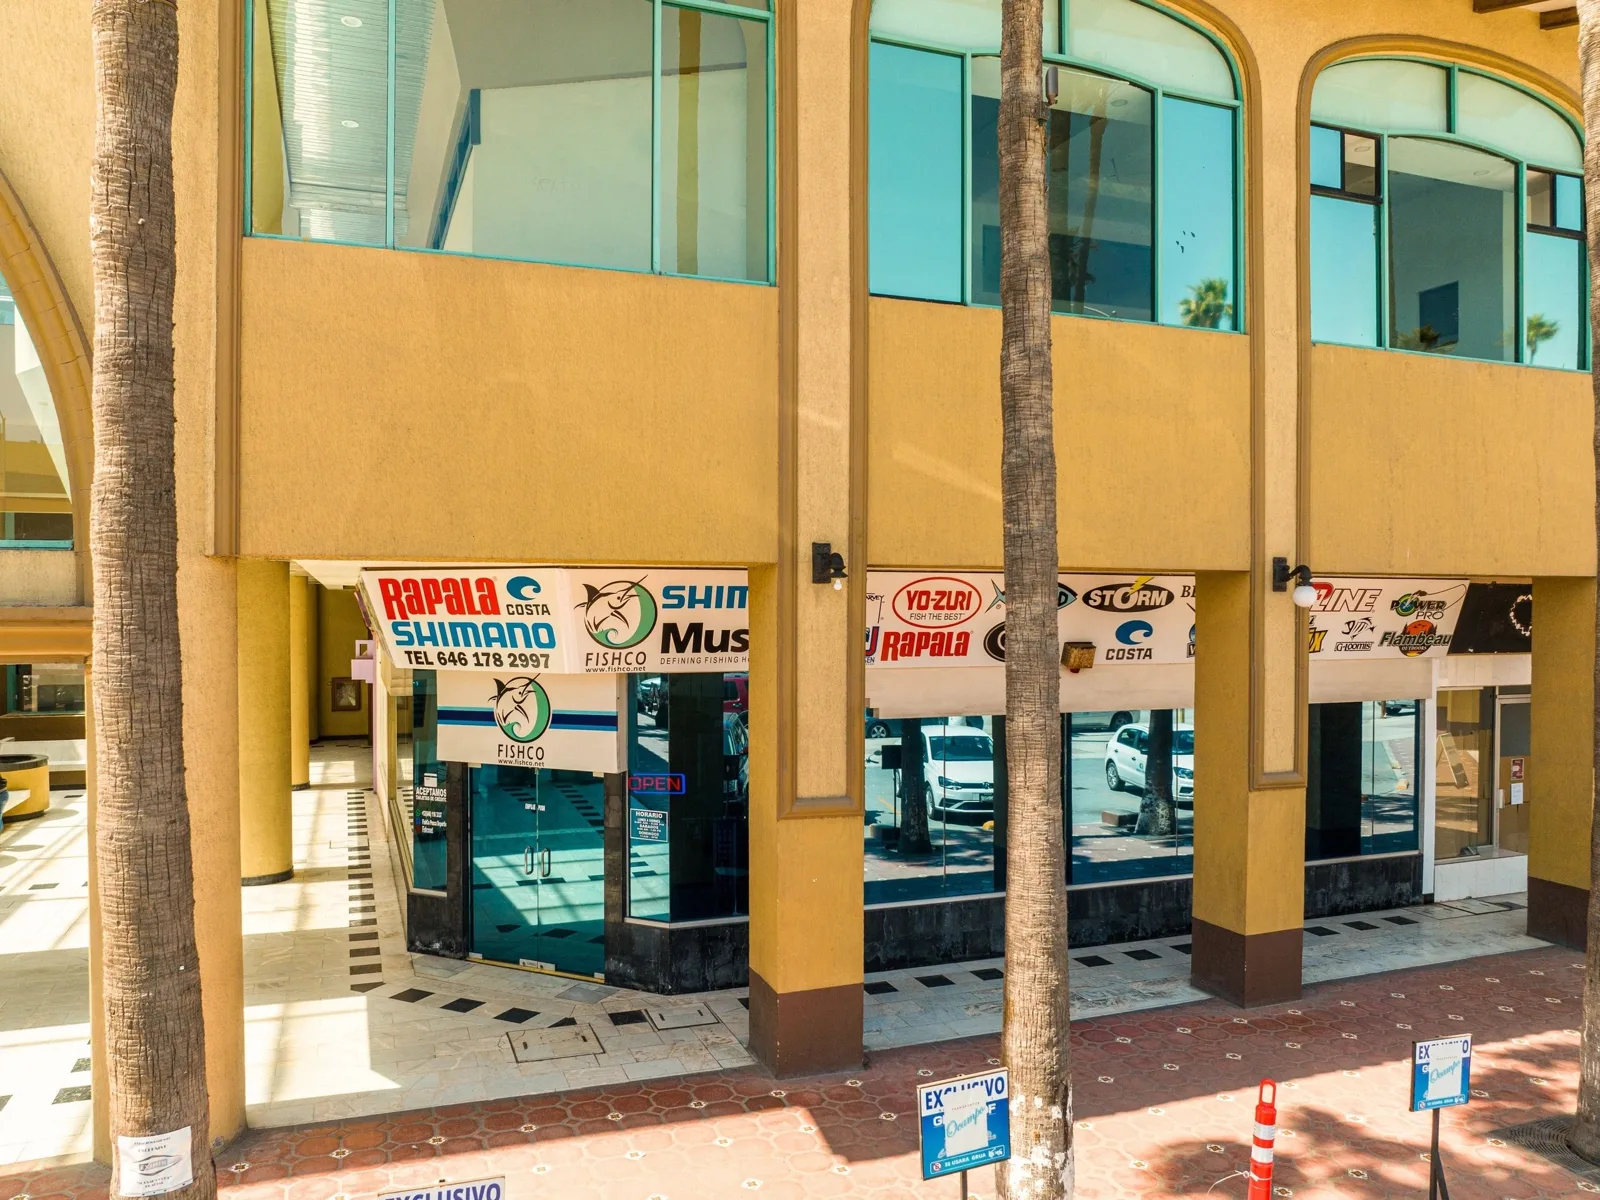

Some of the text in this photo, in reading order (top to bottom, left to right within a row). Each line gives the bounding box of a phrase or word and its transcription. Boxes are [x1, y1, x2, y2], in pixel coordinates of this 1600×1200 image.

[906, 590, 973, 611] YO-ZURI
[1088, 586, 1168, 609] STORM
[506, 604, 551, 616] COSTA
[1390, 594, 1447, 616] POWER
[909, 612, 963, 621] FISH THE BEST
[1415, 611, 1445, 620] PRO
[391, 621, 556, 649] SHIMANO
[1378, 632, 1452, 646] Flambeau
[404, 650, 550, 669] TEL 646 178 2997
[585, 651, 647, 667] FISHCO
[660, 656, 750, 665] DEFINING FISHING H
[1105, 648, 1153, 661] COSTA
[497, 743, 545, 761] FISHCO
[497, 758, 545, 767] www.fishco.net
[628, 776, 681, 791] OPEN
[415, 786, 447, 797] ACEPTAMOS
[635, 811, 663, 819] HORARIO
[971, 1153, 986, 1161] GRUA
